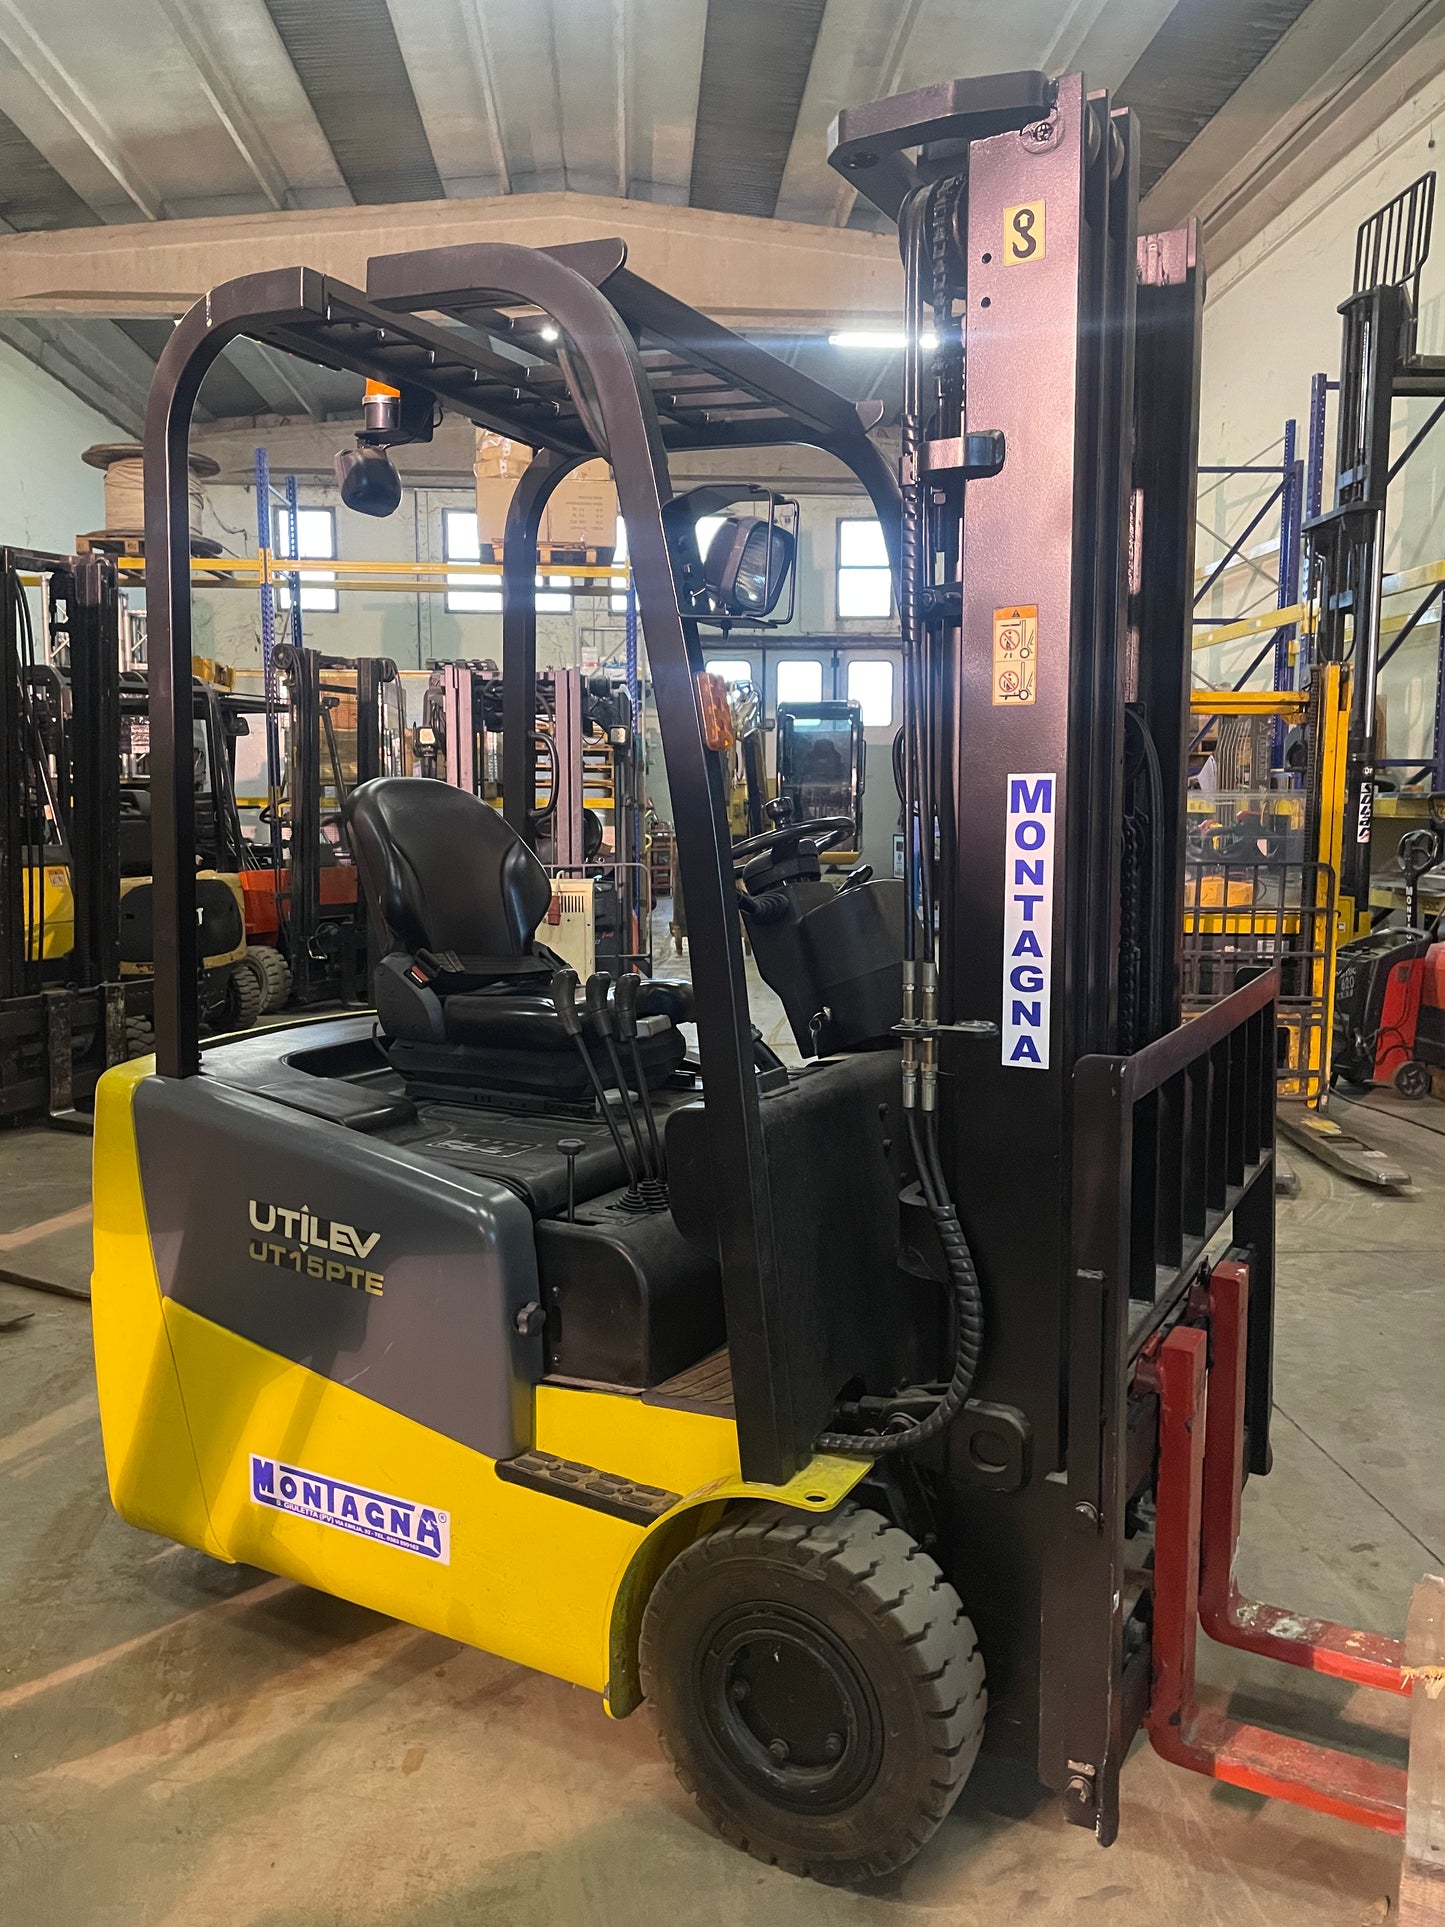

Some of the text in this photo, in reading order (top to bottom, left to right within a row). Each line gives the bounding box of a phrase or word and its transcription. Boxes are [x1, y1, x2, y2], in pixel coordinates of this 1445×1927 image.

[1009, 779, 1052, 1064] MONTAGNA
[249, 1200, 381, 1259] UTILEV
[249, 1242, 384, 1296] UT15PTE
[253, 1457, 441, 1554] MONTAGNA
[284, 1502, 318, 1518] GIULETTA
[319, 1514, 334, 1524] (PV)
